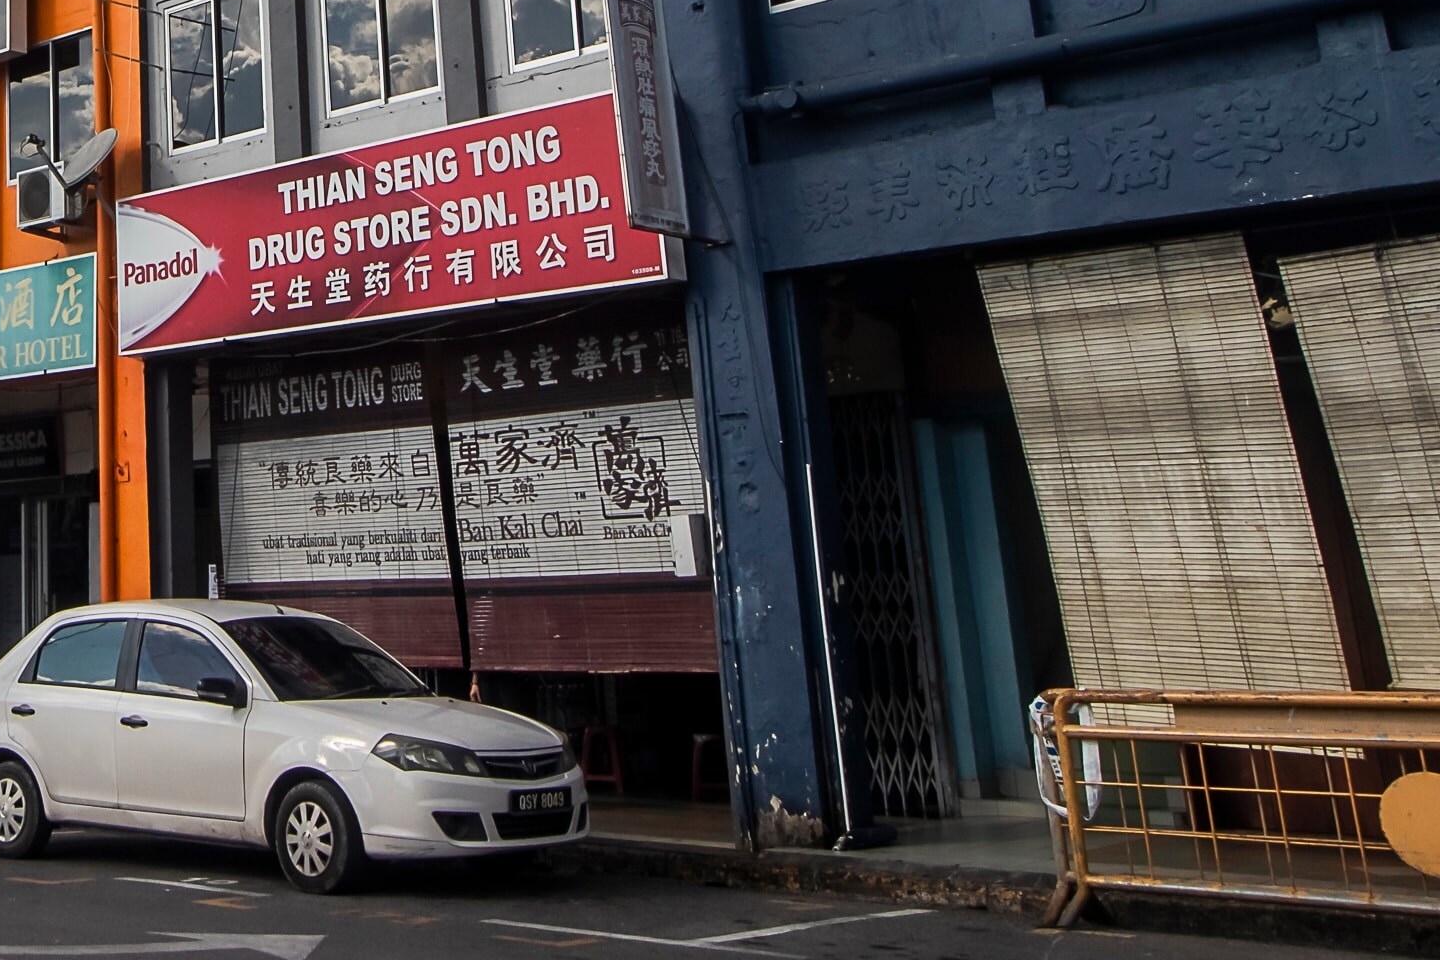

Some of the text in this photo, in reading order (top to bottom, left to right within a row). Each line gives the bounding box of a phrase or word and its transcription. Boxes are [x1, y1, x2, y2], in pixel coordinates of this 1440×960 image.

[277, 125, 562, 217] THIAN SENG TONG
[247, 174, 611, 271] DRUG STORE SDN. BHD.
[122, 247, 201, 288] Panadol
[250, 222, 617, 317] 天生堂药行有限公司
[14, 333, 89, 368] HOTEL
[390, 361, 422, 383] DURG
[220, 366, 385, 422] THIAN SENG TONG
[391, 383, 423, 404] STORE
[262, 527, 441, 551] ubat tradisional yang berkualiti dari
[458, 510, 585, 543] Ban Kah Chai
[603, 525, 627, 540] Ban
[628, 524, 652, 539] Kah
[306, 550, 325, 564] hati
[328, 551, 353, 567] yang
[383, 546, 419, 562] adalah
[420, 545, 447, 561] ubat
[461, 546, 489, 565] yang
[490, 542, 531, 560] terbaik
[518, 791, 565, 811] QSY 8049
